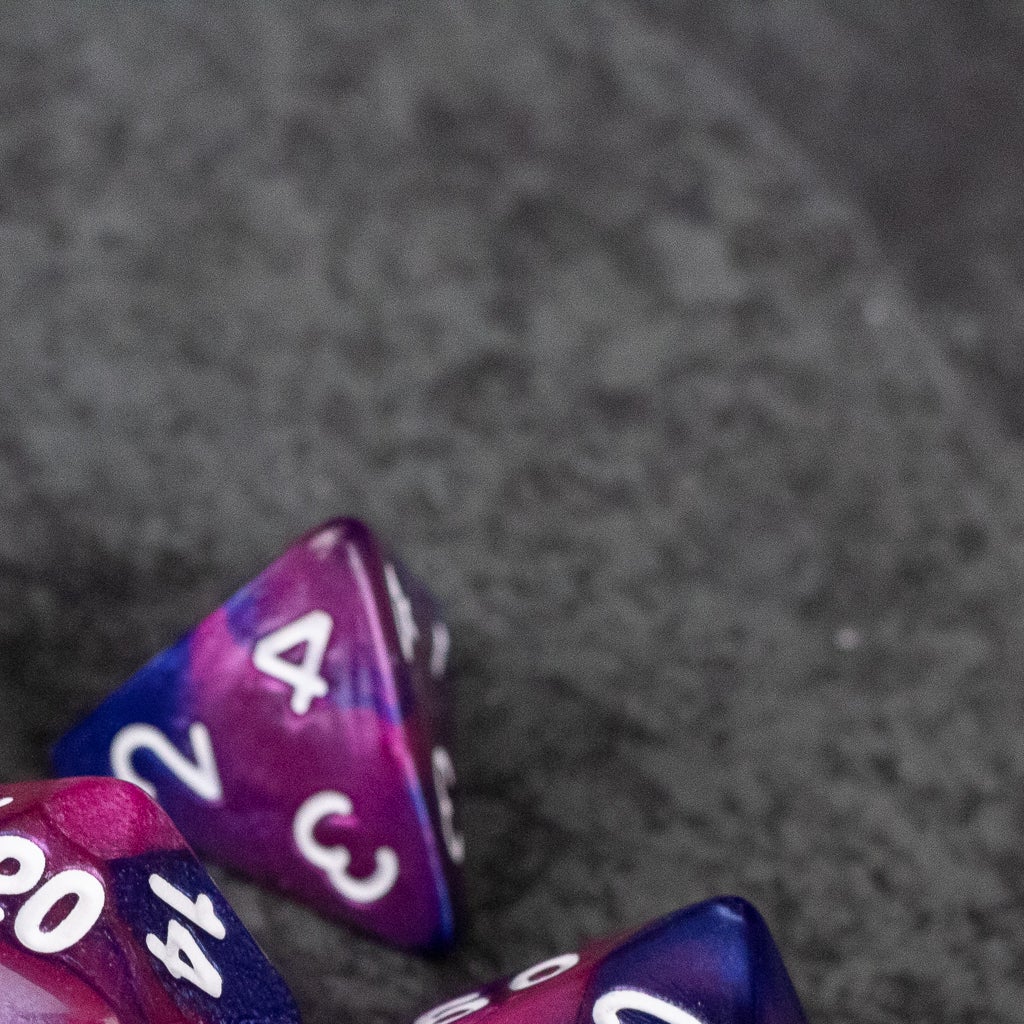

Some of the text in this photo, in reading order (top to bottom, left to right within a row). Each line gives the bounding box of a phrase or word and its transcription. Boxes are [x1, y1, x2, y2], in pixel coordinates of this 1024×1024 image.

[252, 610, 334, 715] 4
[110, 721, 224, 803] 2
[292, 790, 399, 903] 3
[146, 873, 226, 999] 14
